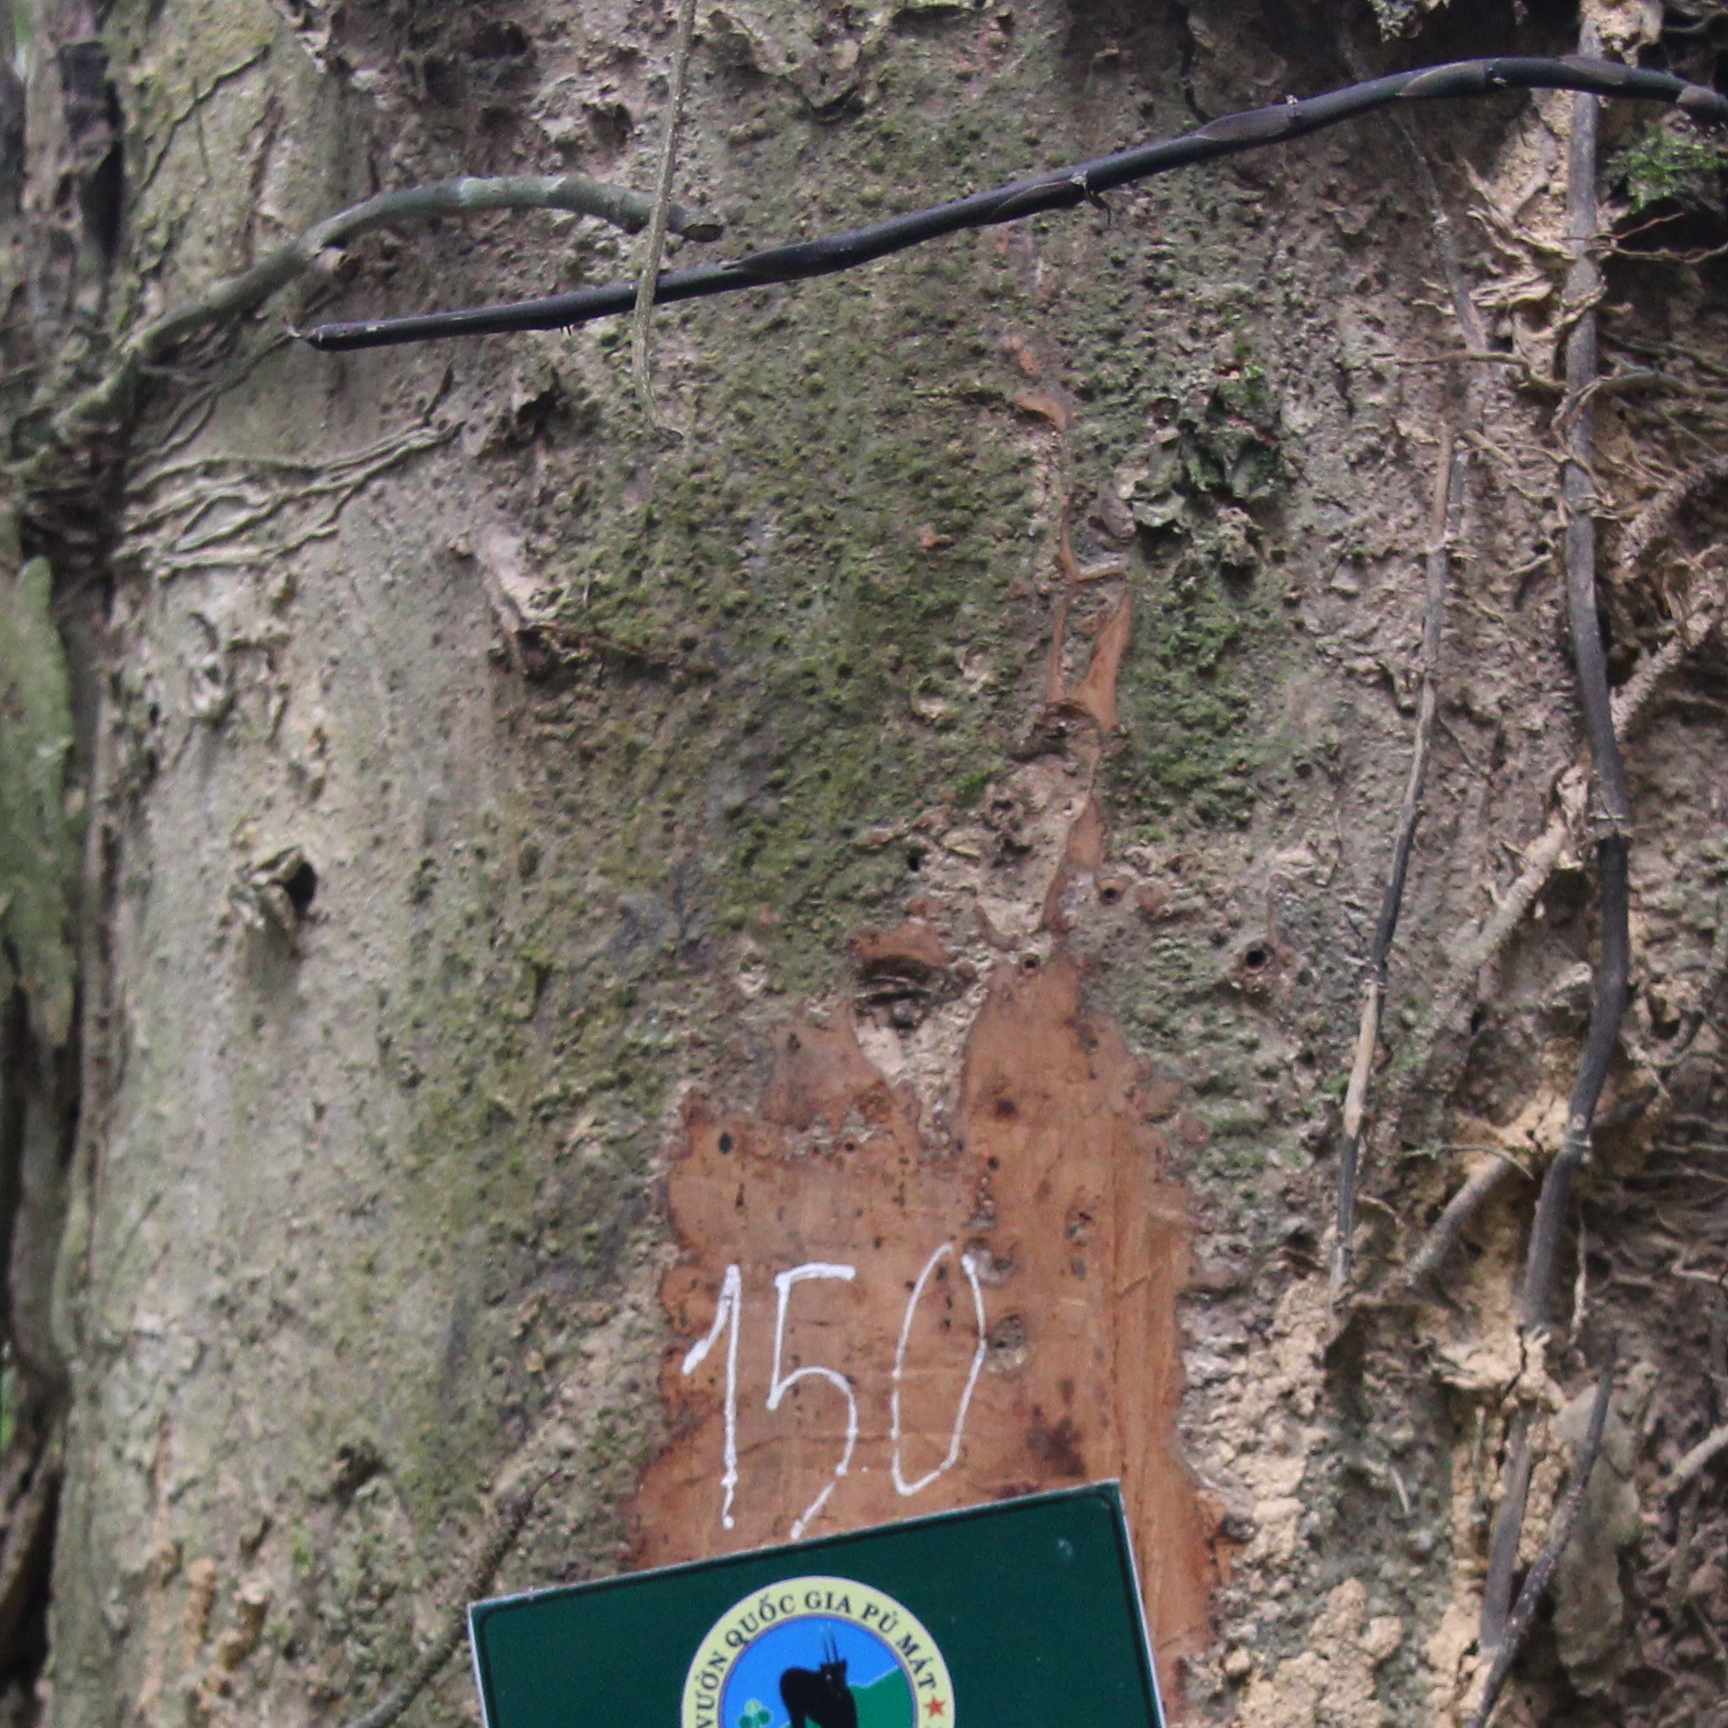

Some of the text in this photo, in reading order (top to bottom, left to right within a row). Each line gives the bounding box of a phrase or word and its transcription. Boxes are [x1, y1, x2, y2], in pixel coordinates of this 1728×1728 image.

[682, 1243, 987, 1540] 150
[725, 1593, 796, 1648] QUỐC
[804, 1590, 852, 1611] GIA
[896, 1633, 937, 1690] MÁT
